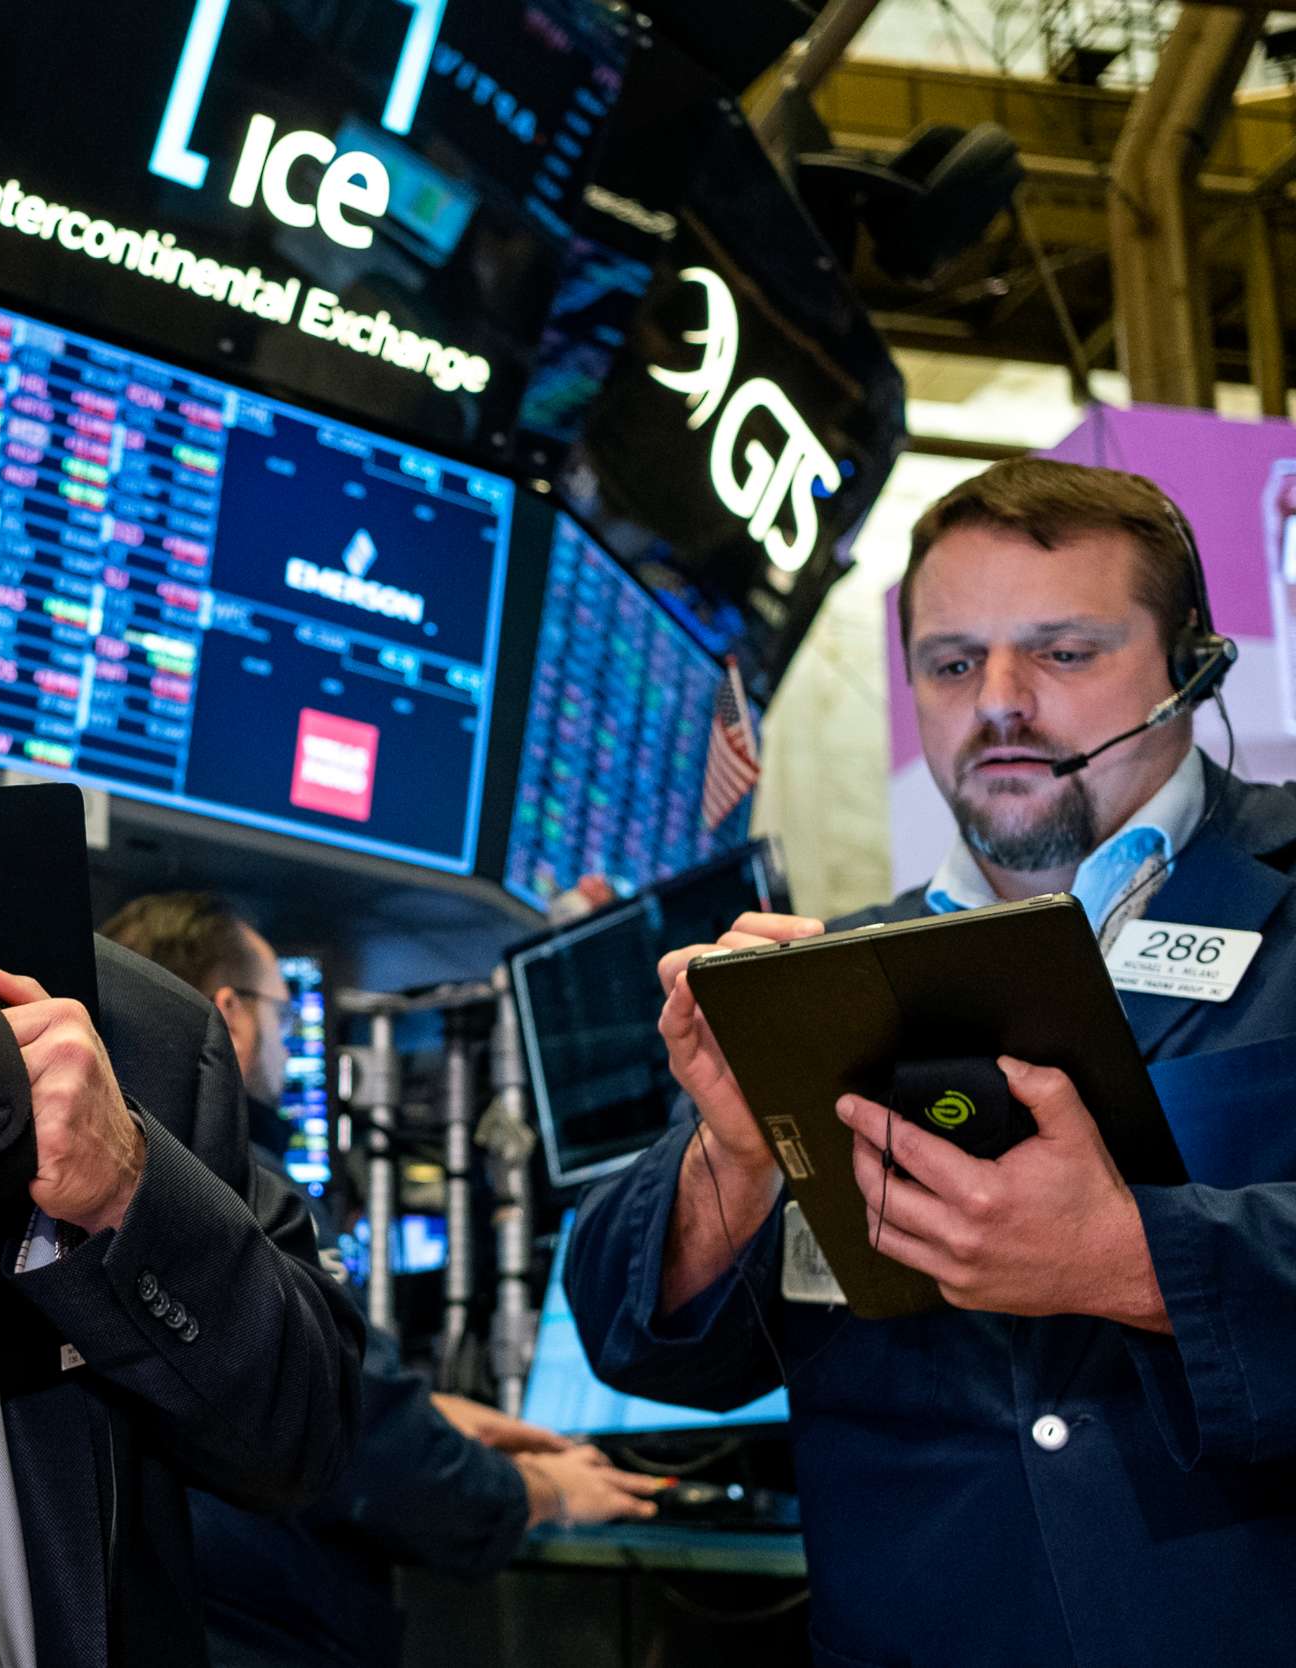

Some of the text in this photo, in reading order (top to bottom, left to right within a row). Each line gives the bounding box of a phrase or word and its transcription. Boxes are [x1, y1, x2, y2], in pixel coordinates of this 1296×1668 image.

[298, 287, 492, 394] Exchange
[710, 377, 842, 573] GTS
[284, 556, 425, 625] EMERSON
[1138, 930, 1226, 965] 286
